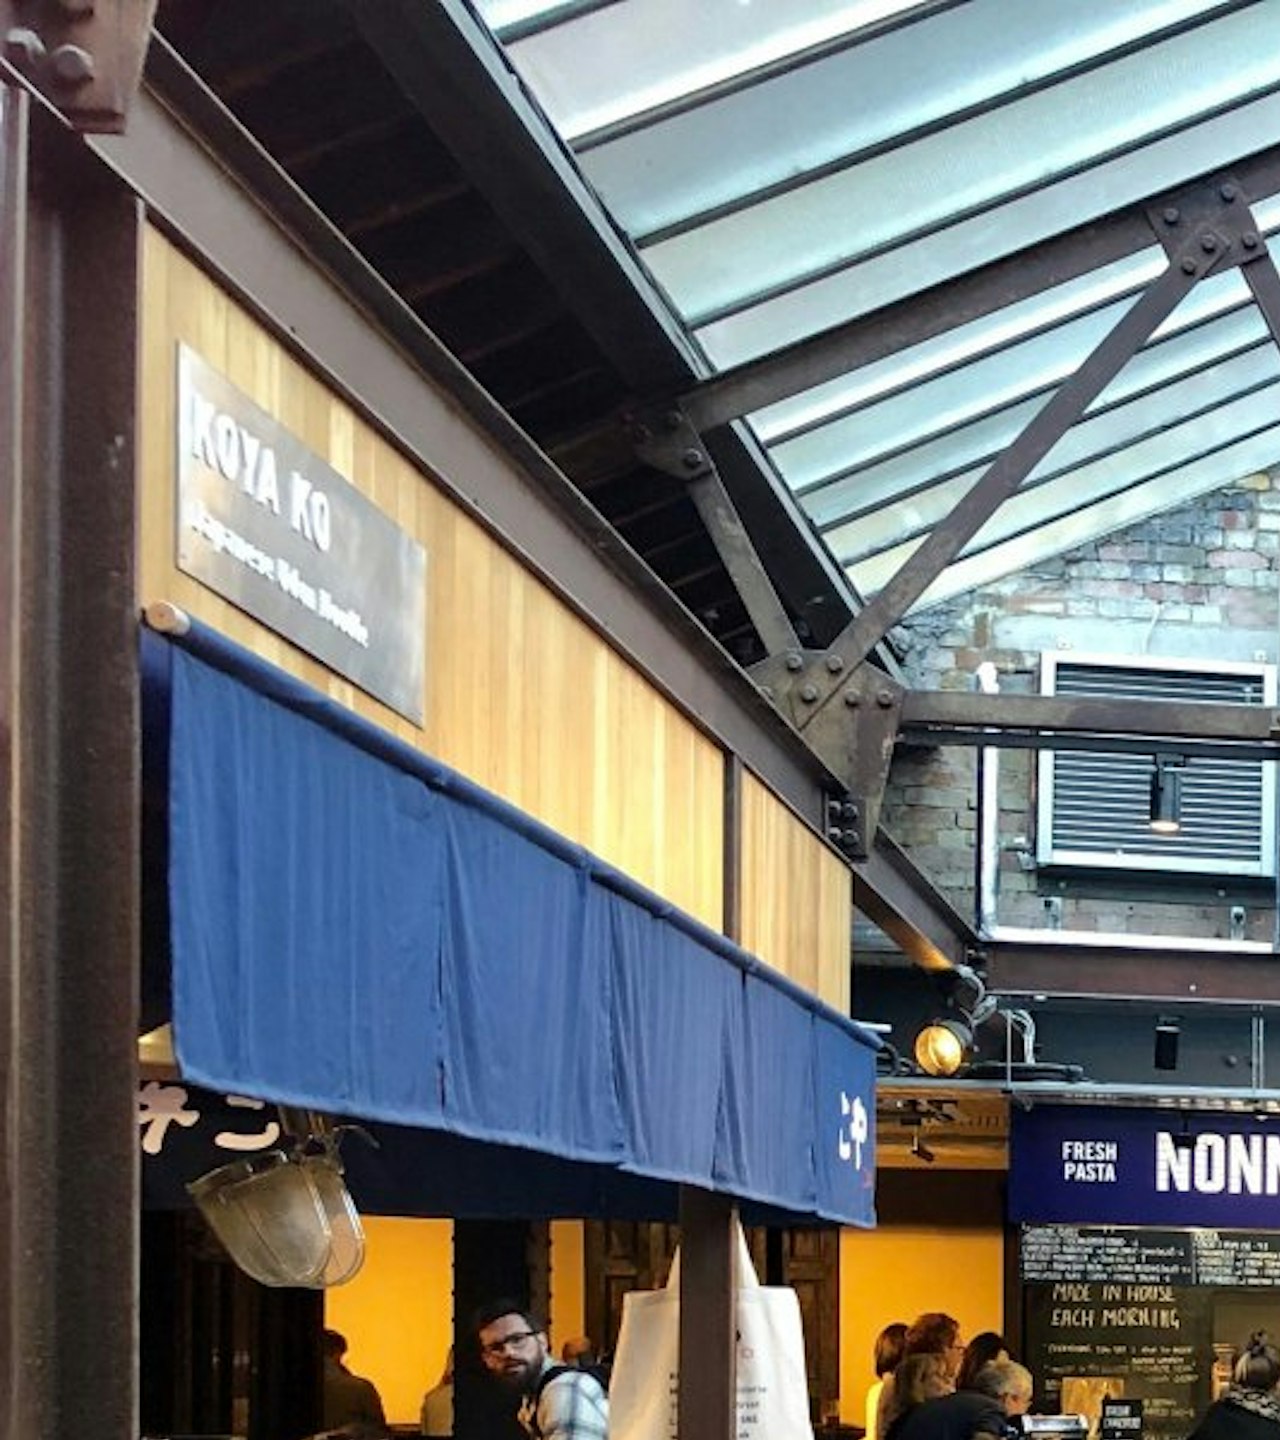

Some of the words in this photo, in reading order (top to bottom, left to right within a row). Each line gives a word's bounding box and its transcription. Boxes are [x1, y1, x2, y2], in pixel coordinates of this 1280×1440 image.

[193, 392, 281, 516] KOYA
[290, 470, 332, 553] KO
[1062, 1141, 1118, 1162] FRESH
[1064, 1162, 1117, 1183] PASTA
[1052, 1282, 1092, 1302] MADE
[1102, 1284, 1122, 1302] IN
[1127, 1284, 1176, 1303] HOUSE
[1051, 1307, 1095, 1328] EACH
[1101, 1306, 1180, 1330] MORNING
